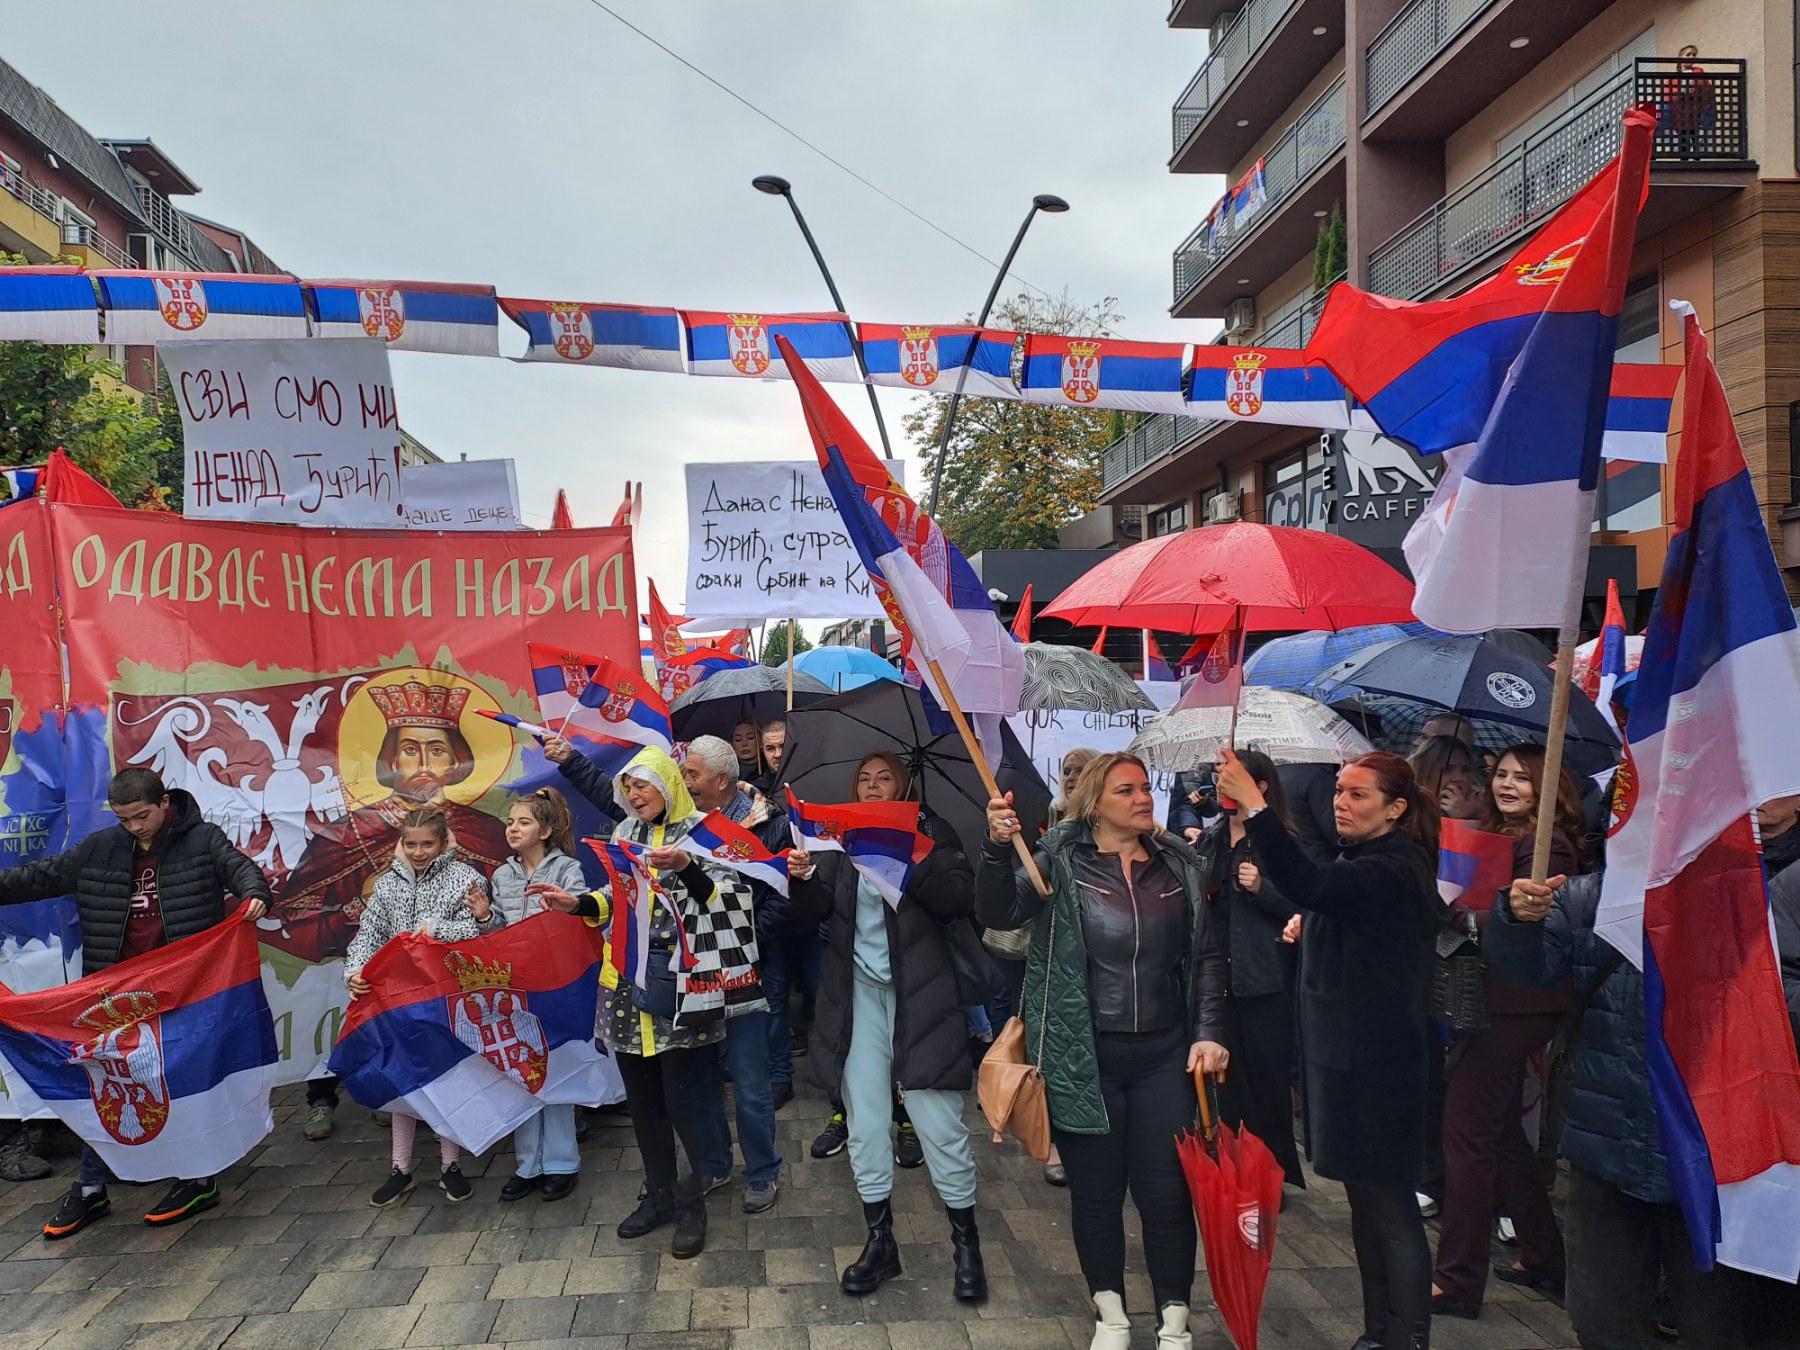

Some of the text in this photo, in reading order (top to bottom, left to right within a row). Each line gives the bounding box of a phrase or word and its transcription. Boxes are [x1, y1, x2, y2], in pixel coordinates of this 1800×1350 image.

[275, 376, 342, 426] СМО
[192, 449, 286, 507] НЕНАД
[701, 470, 841, 515] Данас Нена
[0, 529, 32, 603] Д
[71, 534, 628, 619] ОДАВДЕ НЕМА НАЗАД
[845, 561, 872, 598] Ки
[1083, 712, 1154, 732] CHILDRE
